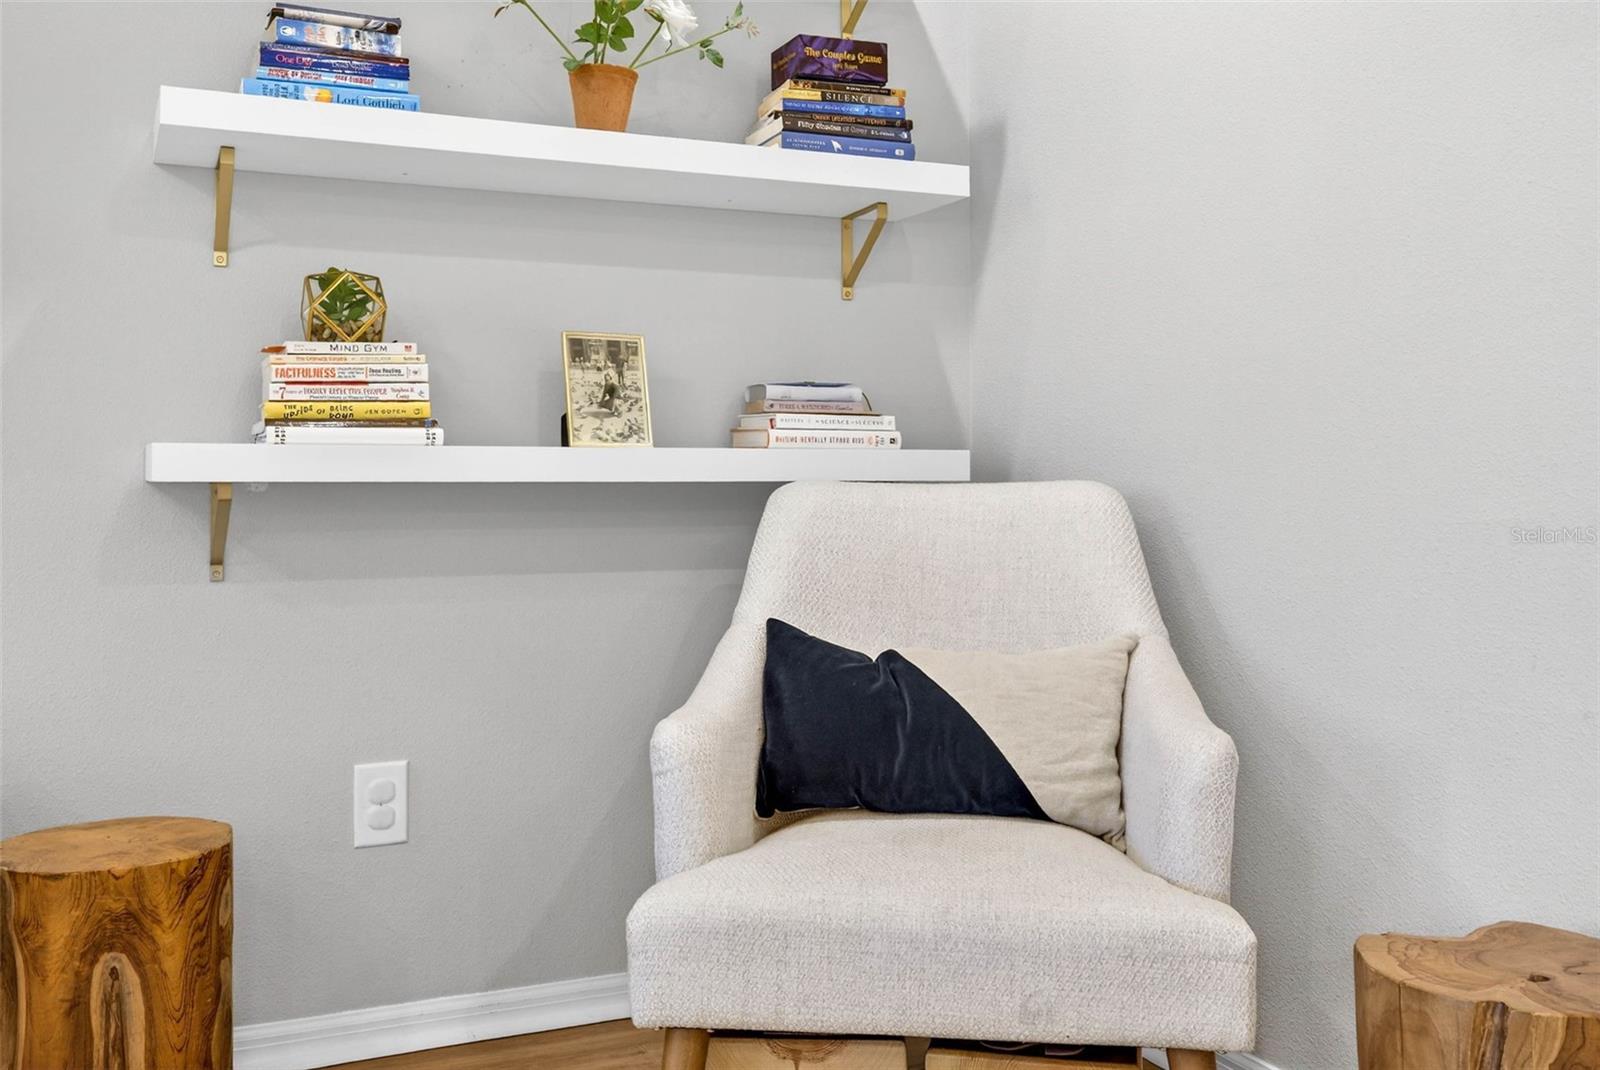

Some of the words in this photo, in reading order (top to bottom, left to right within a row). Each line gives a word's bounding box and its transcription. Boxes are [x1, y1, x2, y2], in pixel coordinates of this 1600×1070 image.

[275, 53, 295, 64] One
[804, 46, 820, 57] The
[823, 49, 855, 61] Couples
[858, 52, 882, 64] Game
[336, 94, 359, 106] Lori
[363, 97, 405, 110] Gottlieb
[826, 93, 873, 104] SILENCE
[329, 344, 360, 352] MIND
[364, 344, 388, 352] GYM
[274, 367, 337, 378] FACTFULNESS
[279, 386, 286, 399] 7
